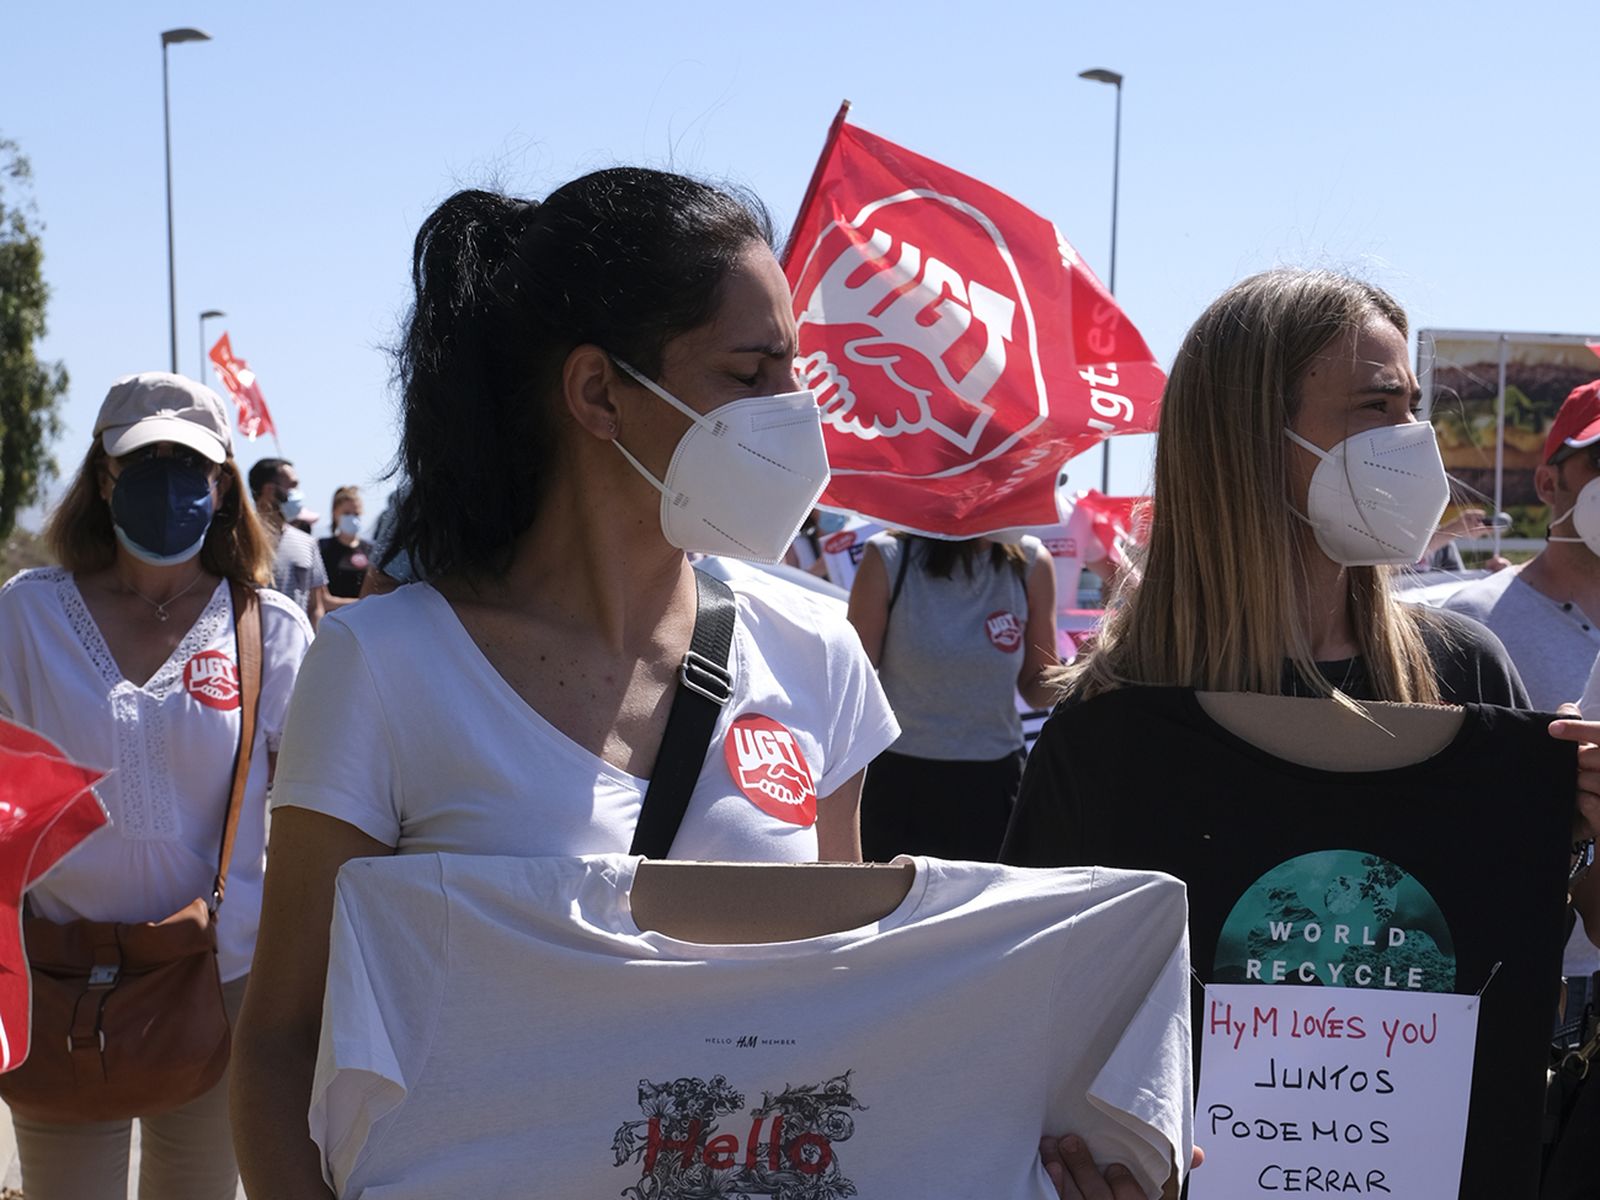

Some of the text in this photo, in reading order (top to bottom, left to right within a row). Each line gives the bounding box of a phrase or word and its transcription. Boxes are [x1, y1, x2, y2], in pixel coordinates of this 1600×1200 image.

[808, 228, 1016, 402] UGT
[987, 614, 1017, 635] UGT
[190, 657, 237, 681] UGT
[733, 727, 800, 770] UGT
[1270, 922, 1404, 945] WORLD
[1245, 960, 1423, 988] RECYCLE
[1291, 1007, 1366, 1039] LOVES
[1255, 1058, 1394, 1094] JUNTOS
[1208, 1104, 1389, 1144] PODEMOS
[643, 1115, 834, 1176] Hello
[1258, 1165, 1391, 1193] CERRAR
